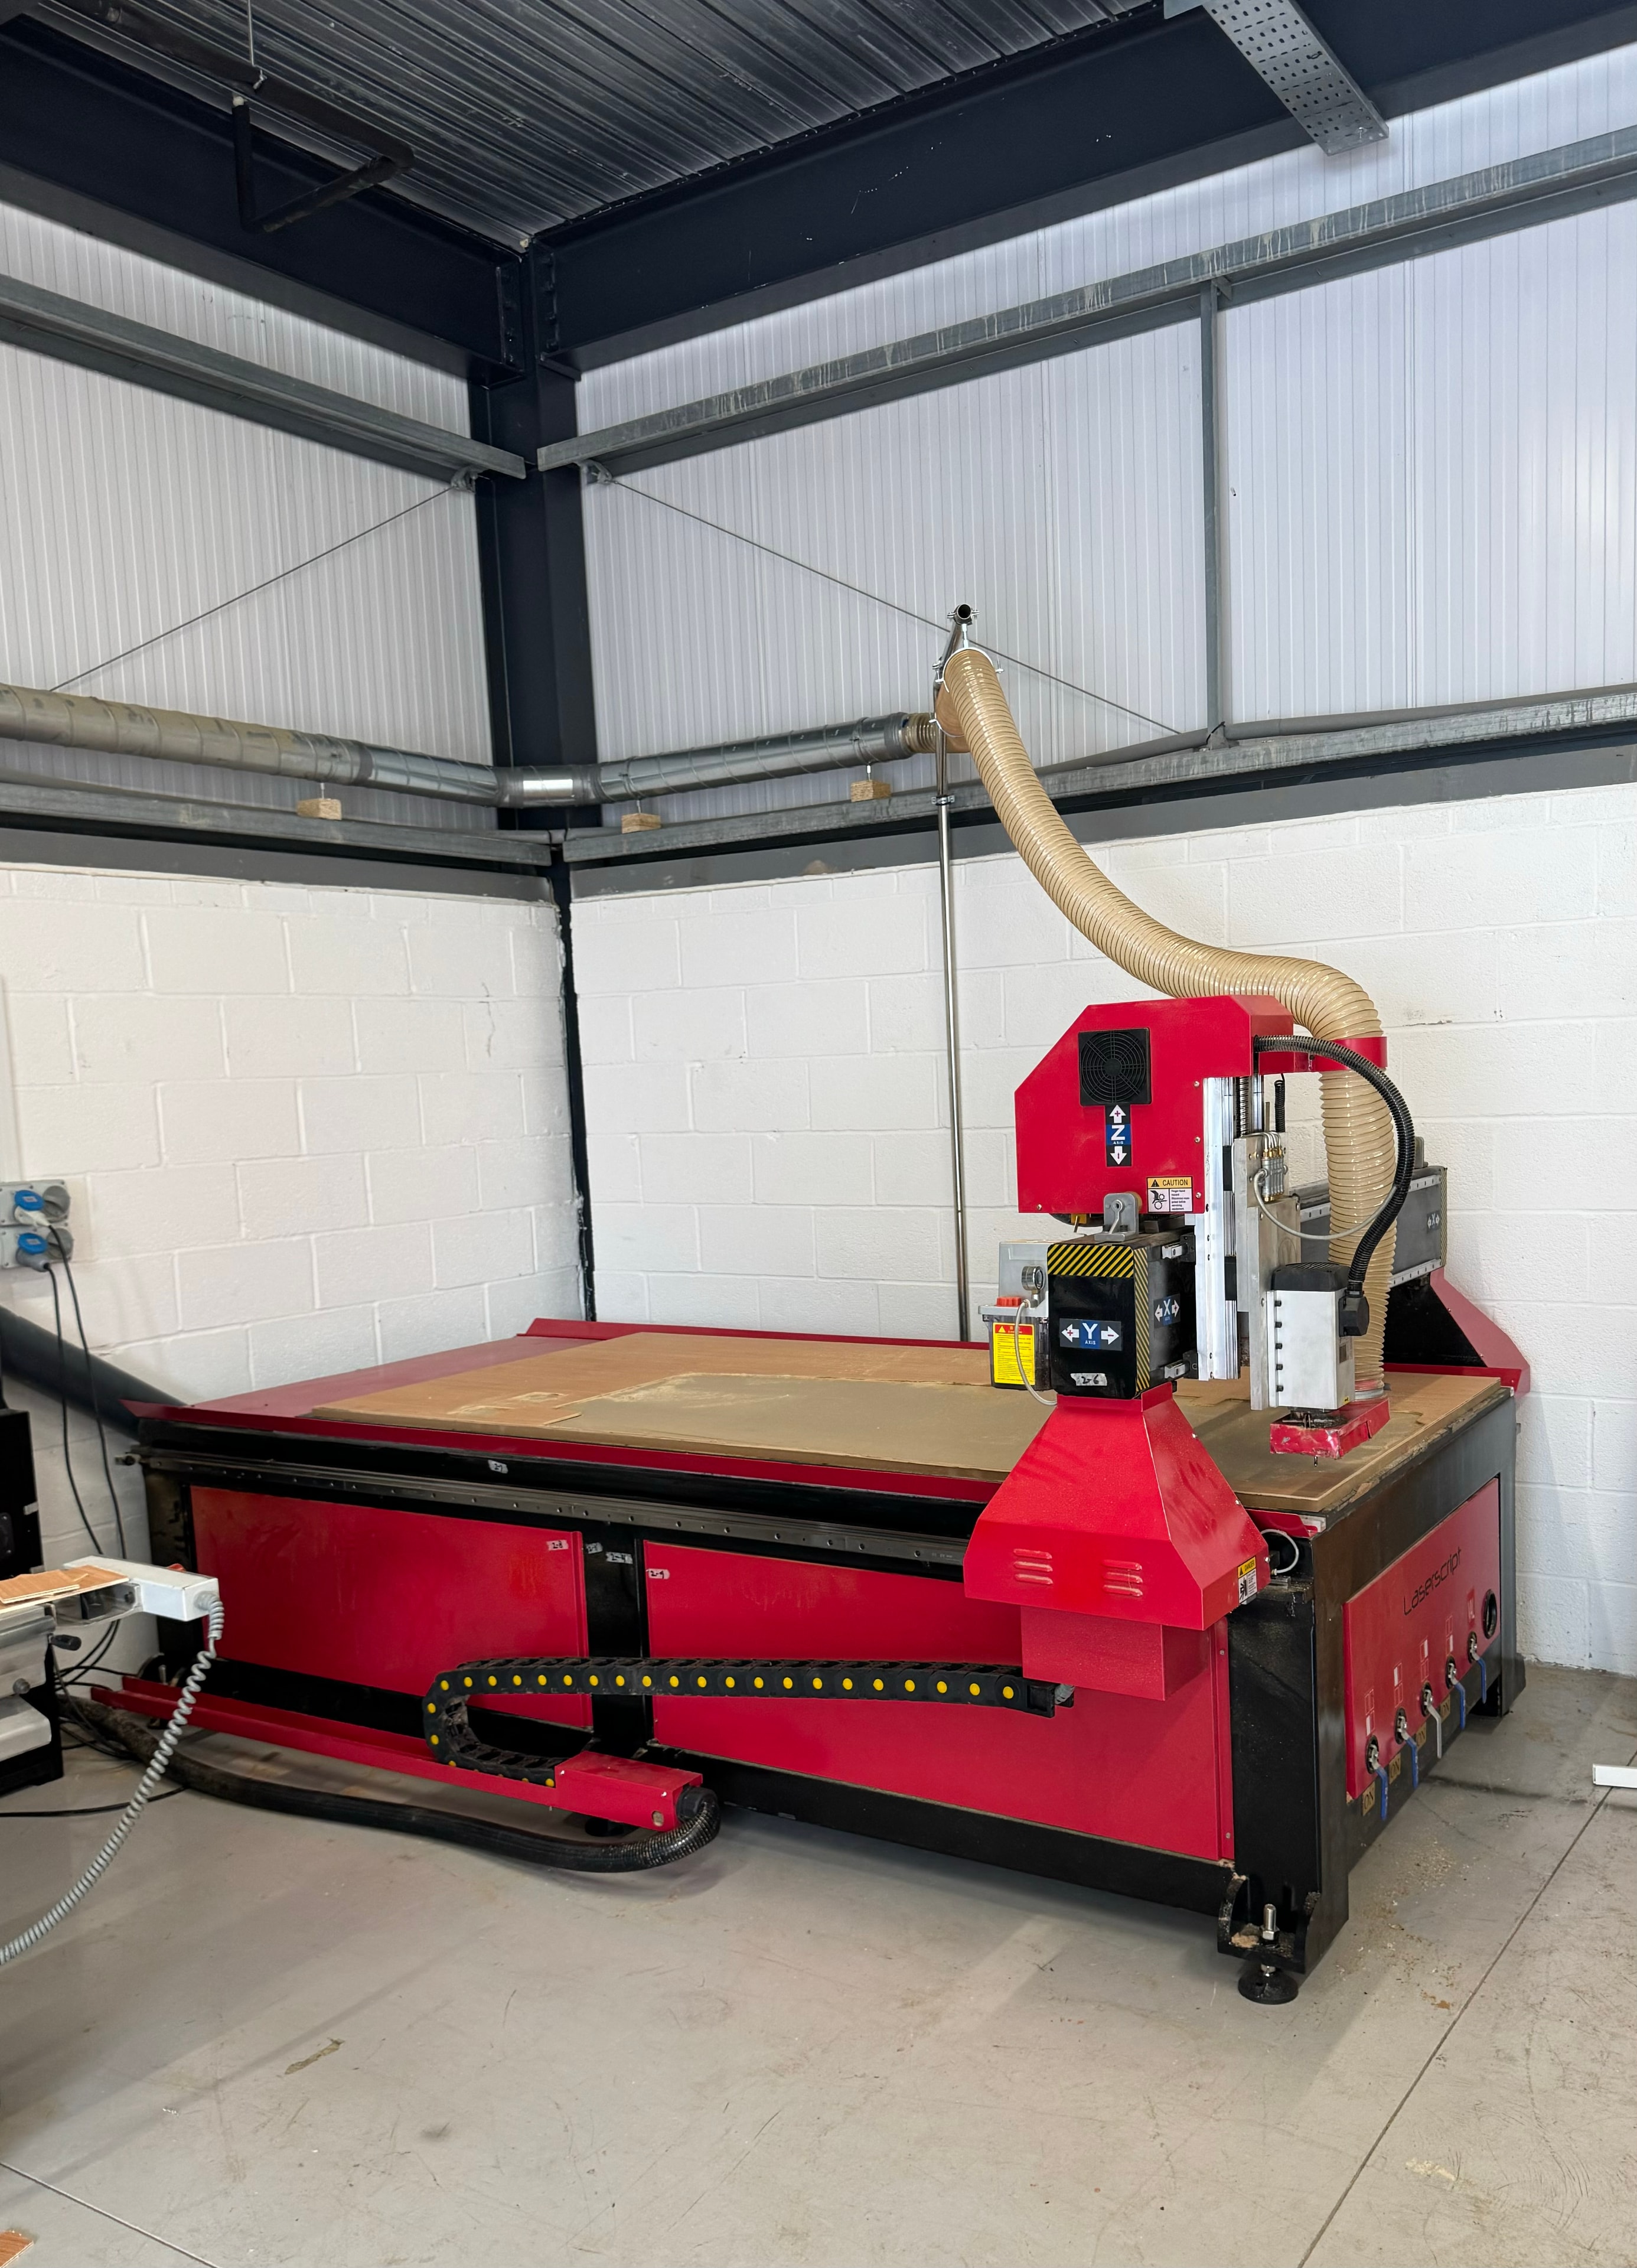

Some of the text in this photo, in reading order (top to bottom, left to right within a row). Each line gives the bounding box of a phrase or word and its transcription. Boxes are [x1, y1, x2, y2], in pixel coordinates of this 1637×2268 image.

[1111, 1125, 1126, 1140] Z
[1163, 1299, 1170, 1317] X
[1082, 1322, 1098, 1340] Y
[1403, 1546, 1461, 1616] Laserscript
